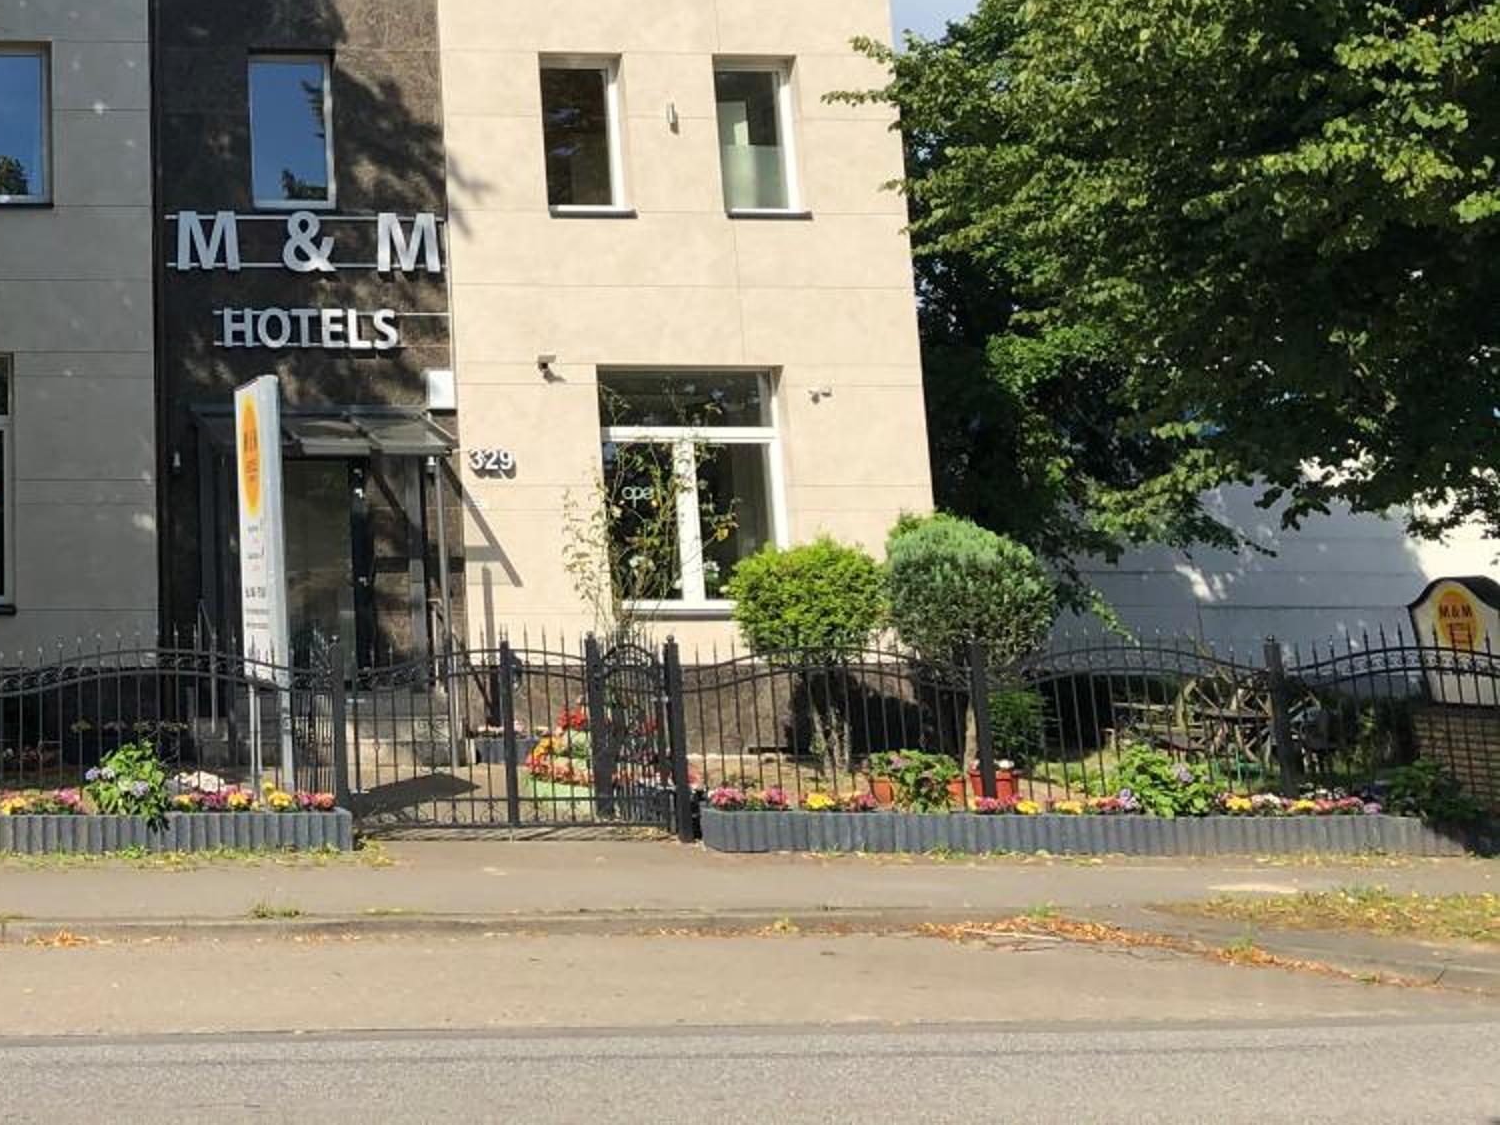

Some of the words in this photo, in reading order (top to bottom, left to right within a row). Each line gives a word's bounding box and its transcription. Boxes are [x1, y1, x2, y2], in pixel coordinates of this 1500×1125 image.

[176, 210, 241, 271] M
[282, 210, 336, 272] &
[376, 212, 441, 272] M
[222, 308, 399, 350] HOTELS
[469, 450, 513, 470] 329
[621, 486, 656, 509] ope
